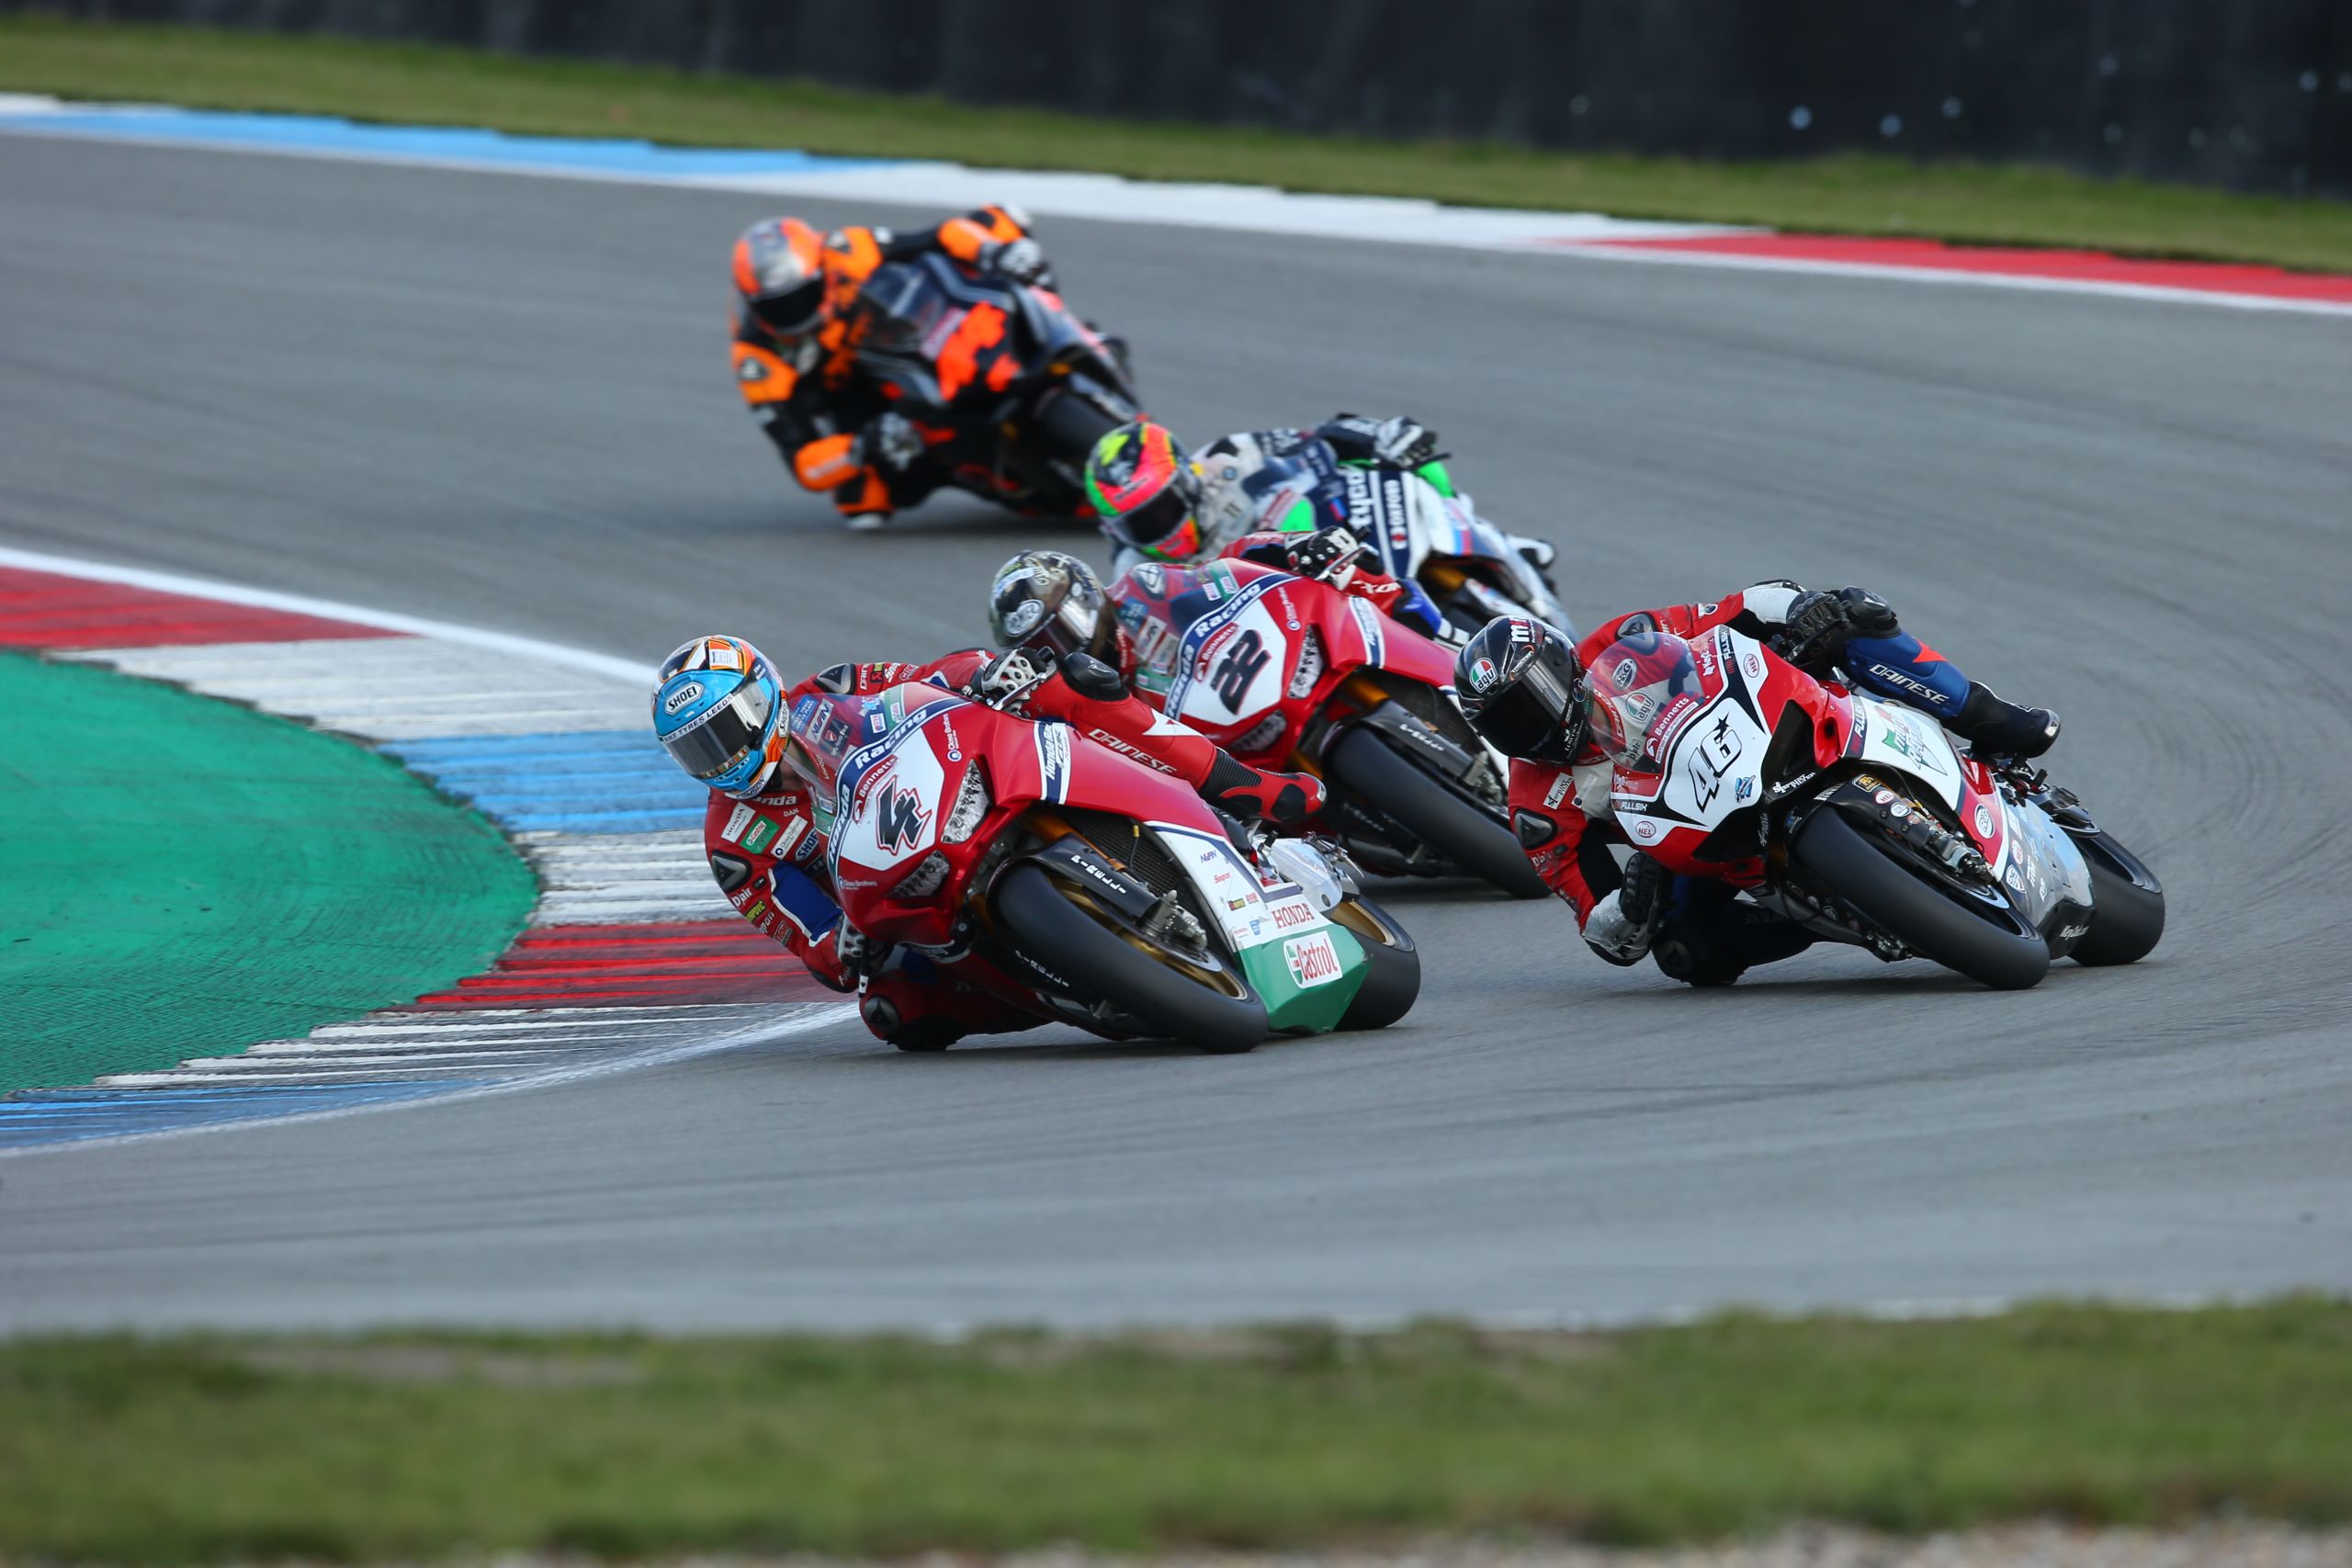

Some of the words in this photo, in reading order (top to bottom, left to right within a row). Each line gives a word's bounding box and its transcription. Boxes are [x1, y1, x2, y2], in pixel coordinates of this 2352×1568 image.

[1195, 584, 1261, 637] Racing
[1202, 626, 1237, 660] Bennetts
[860, 663, 868, 690] DAIN
[1210, 629, 1271, 716] 22
[1617, 663, 1631, 686] R&G
[1869, 663, 1950, 705] DAINESE
[668, 685, 698, 711] SHOEI
[678, 716, 705, 735] TYRES
[707, 694, 733, 717] LEEDS
[1655, 697, 1690, 736] Bennetts
[1045, 742, 1056, 780] Honda
[1088, 728, 1177, 773] DAINESE
[828, 784, 850, 863] Honda
[854, 709, 927, 770] Racing
[859, 758, 896, 796] Bennetts
[1688, 728, 1743, 814] 46
[753, 795, 797, 806] nda
[784, 808, 799, 818] DAN
[877, 778, 928, 853] 4
[1621, 802, 1647, 811] FULLSIX
[728, 808, 744, 836] HONDA
[1071, 855, 1126, 894] PIRELLI
[1272, 903, 1315, 929] HONDA
[1015, 950, 1069, 987] PIRELLI
[1296, 938, 1338, 981] Castrol
